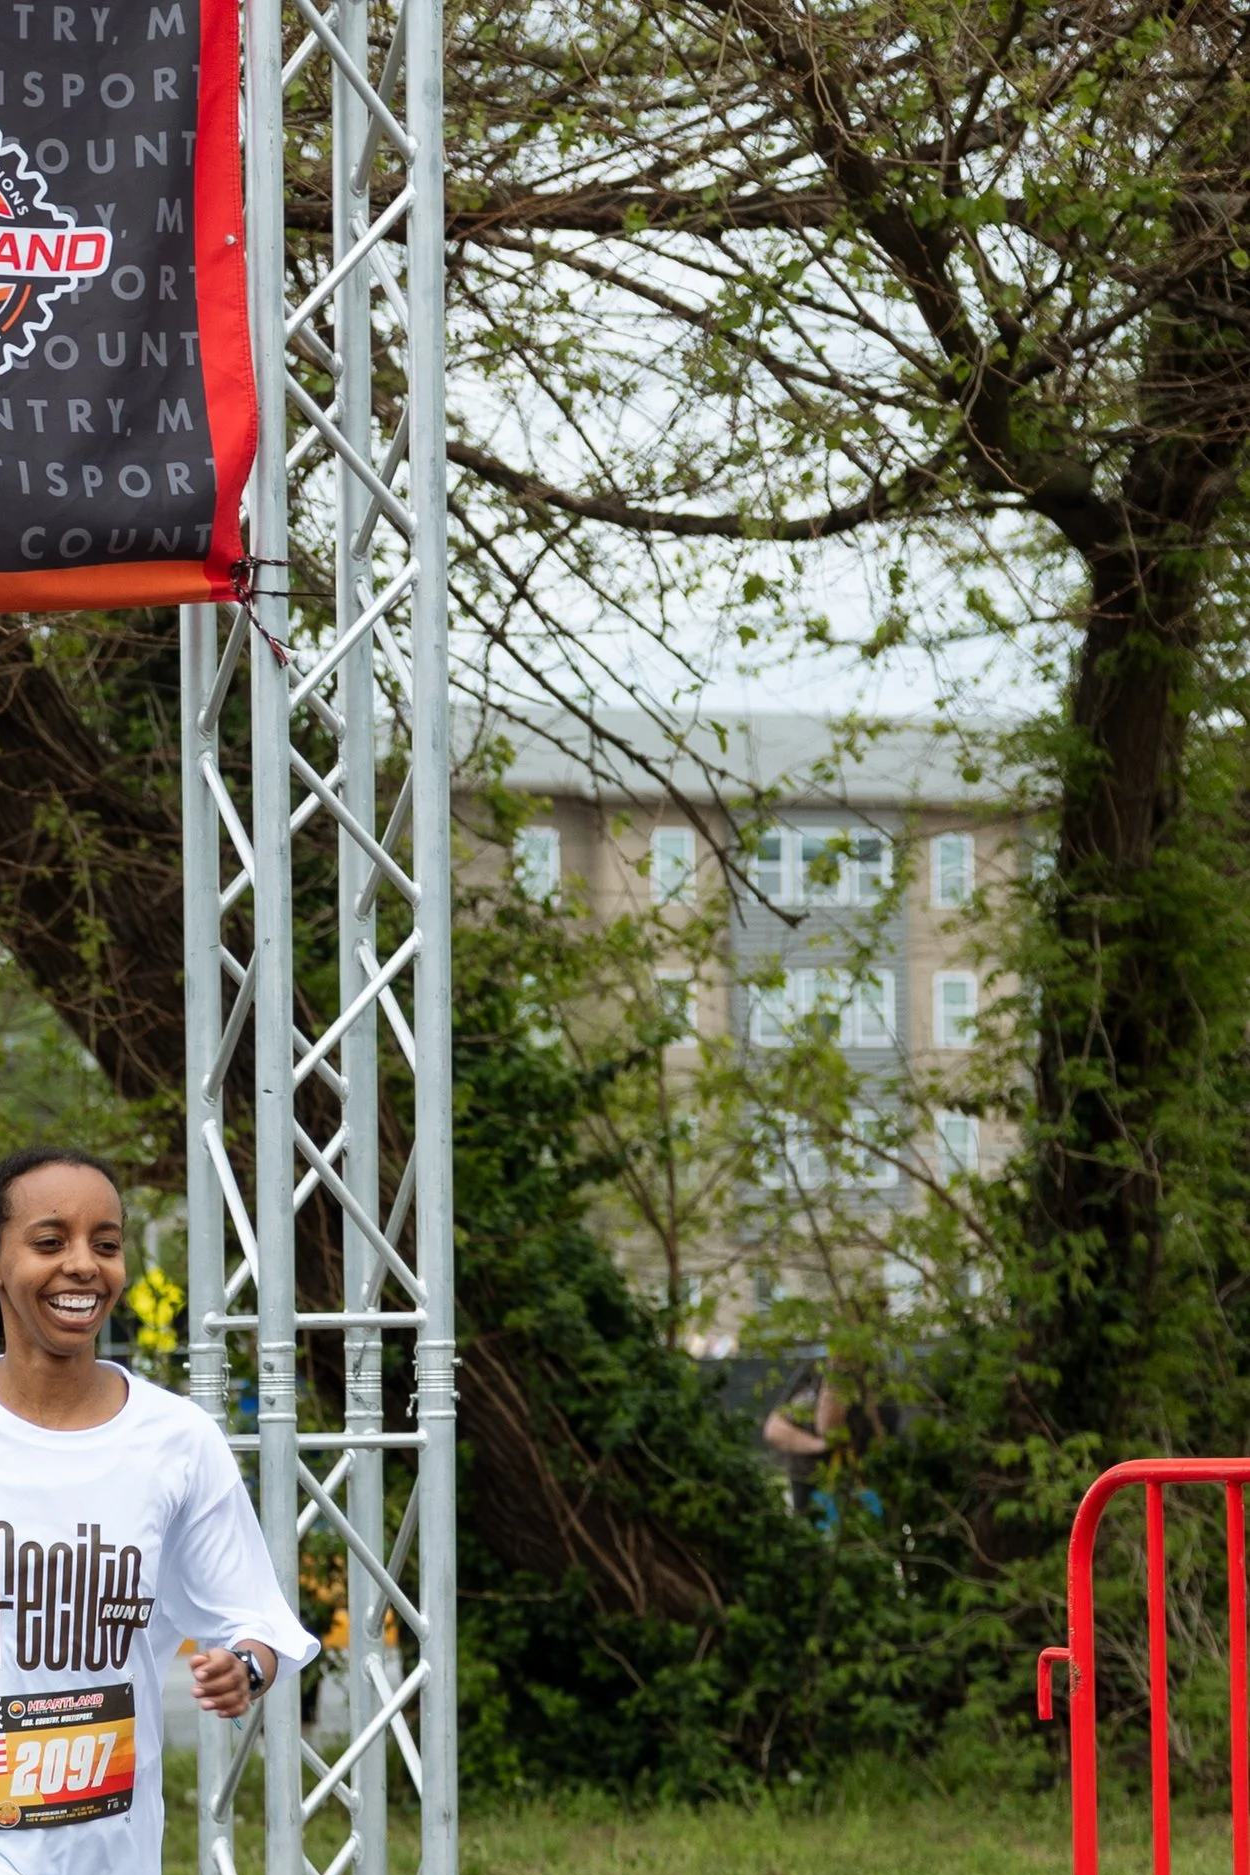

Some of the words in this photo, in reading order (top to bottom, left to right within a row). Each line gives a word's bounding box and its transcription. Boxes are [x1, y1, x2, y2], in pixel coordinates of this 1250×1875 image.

[101, 1603, 137, 1620] RUN
[27, 1693, 104, 1712] HEARTLAND
[10, 1732, 117, 1797] 2097
